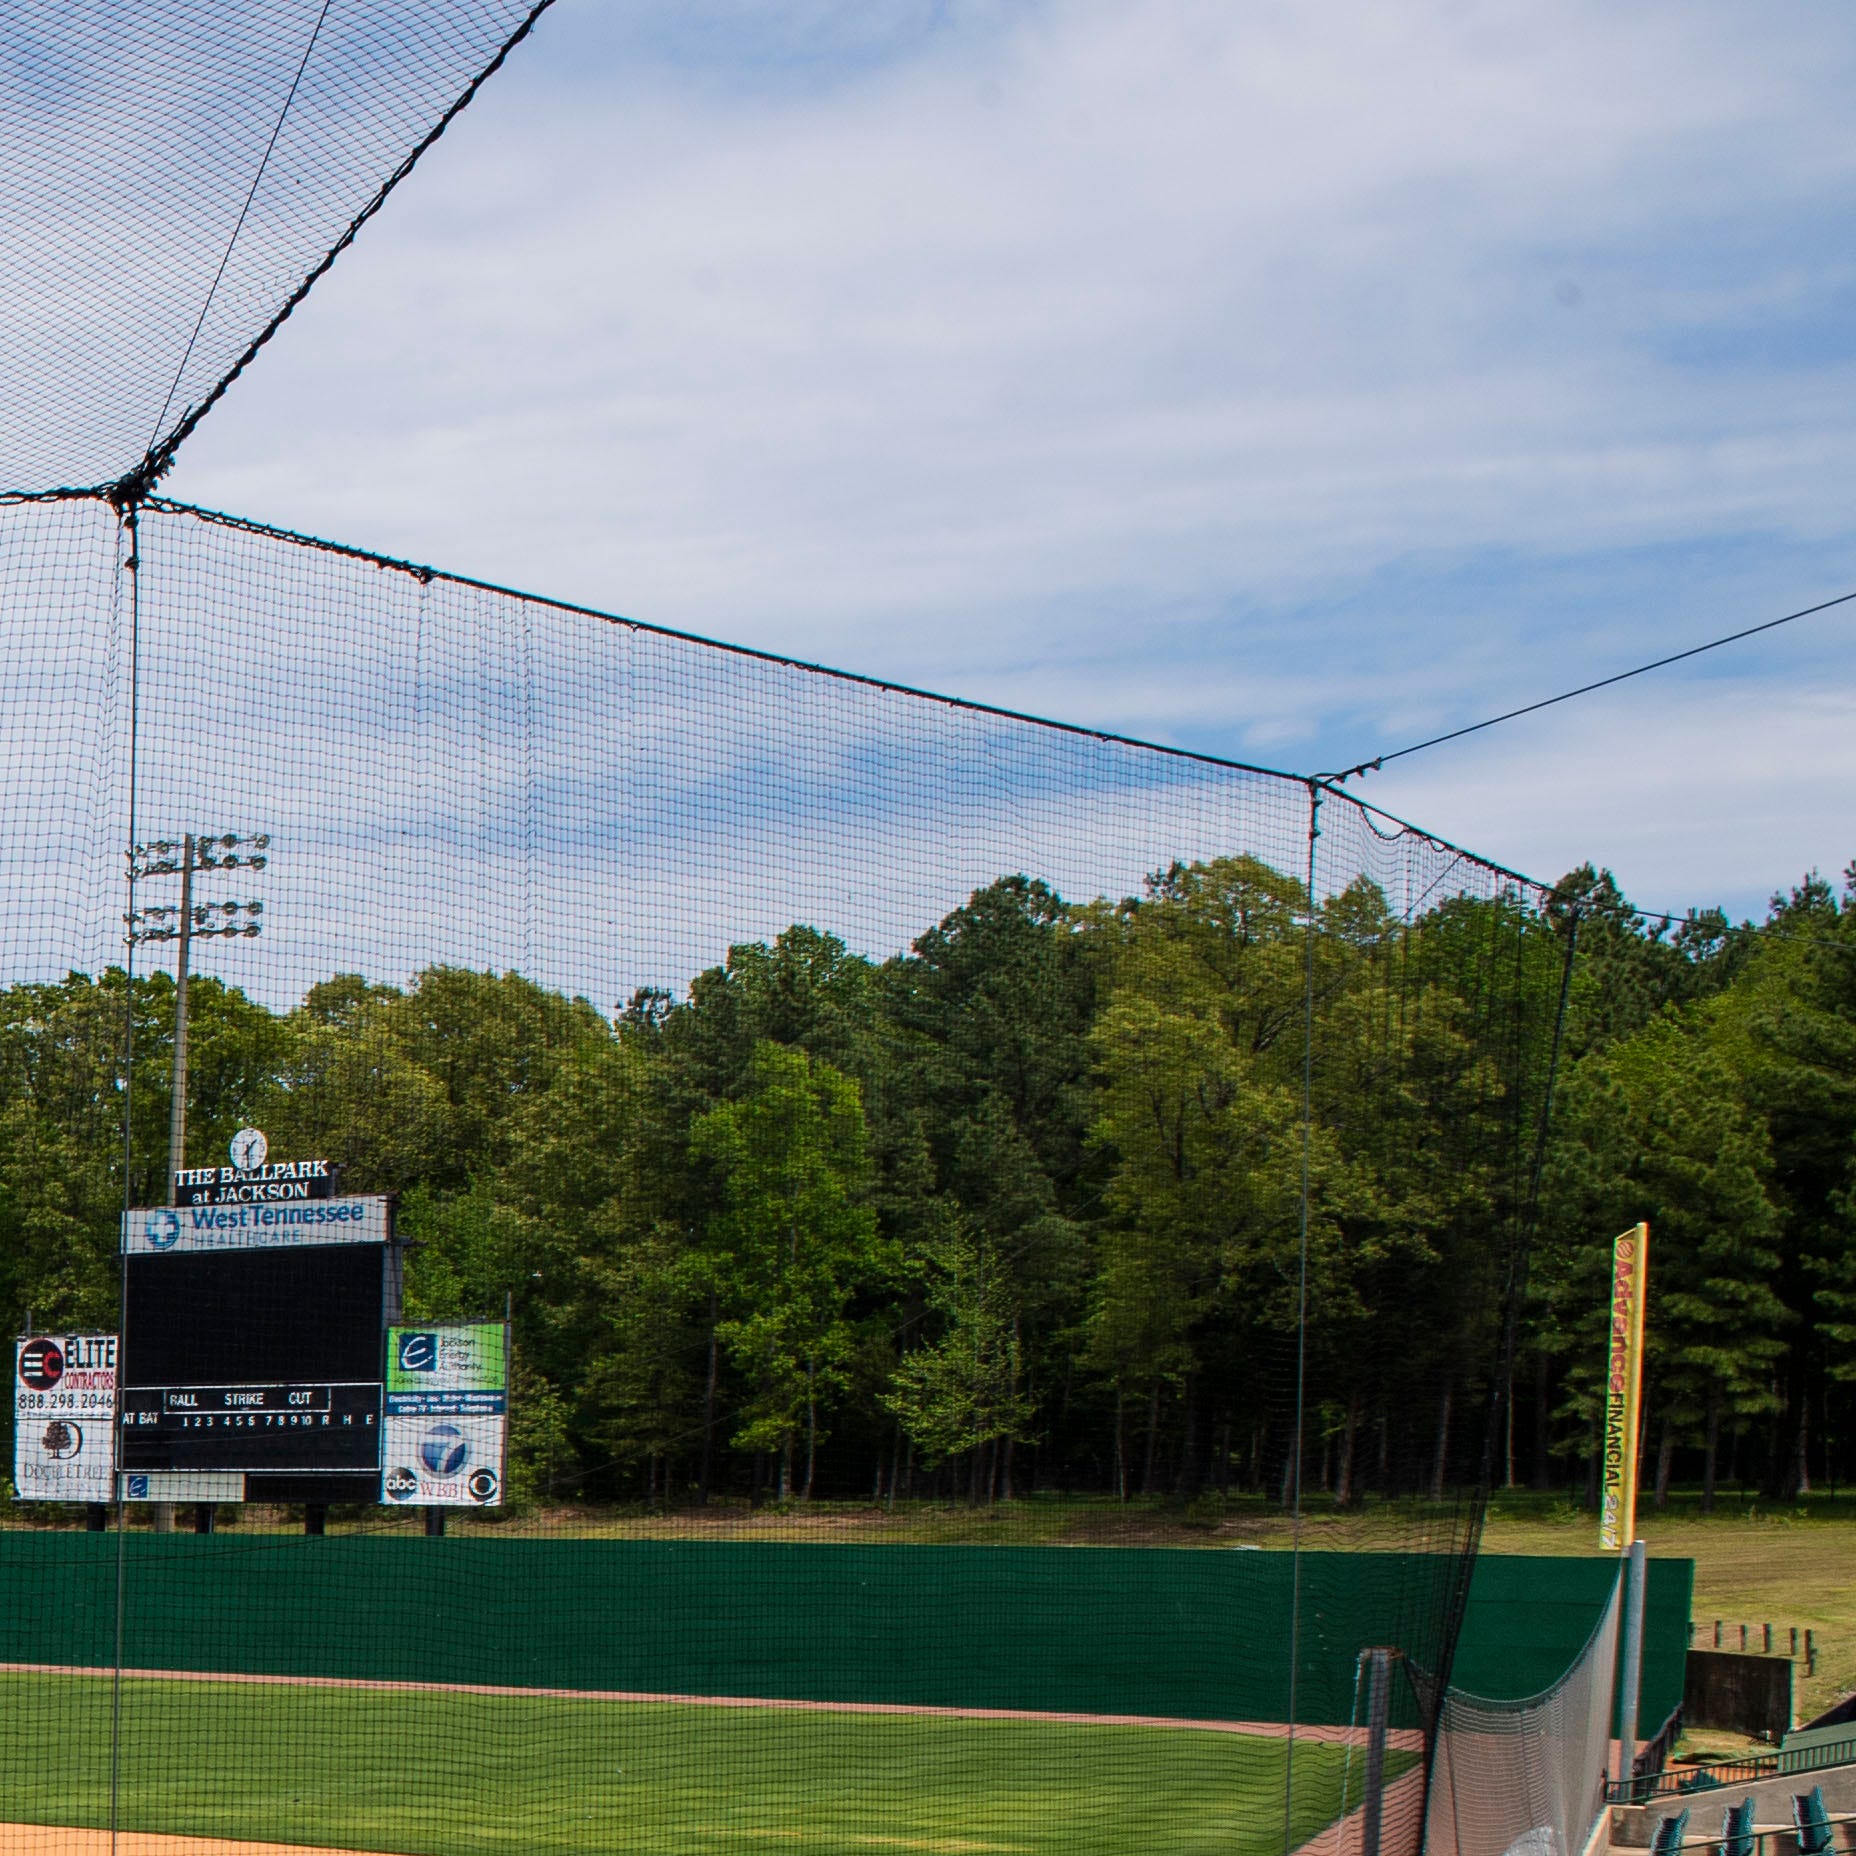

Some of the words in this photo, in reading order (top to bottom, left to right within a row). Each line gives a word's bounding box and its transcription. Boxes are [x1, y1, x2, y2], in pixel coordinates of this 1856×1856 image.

[175, 1168, 216, 1186] THE
[220, 1161, 329, 1183] BALLPARK
[192, 1189, 210, 1204] at
[215, 1182, 309, 1203] JACKSON
[191, 1208, 248, 1230] West
[249, 1203, 364, 1227] Tennessee
[64, 1339, 116, 1369] ELITE
[64, 1372, 114, 1390] CONTRACTORS
[19, 1393, 113, 1409] 888.298.2046
[170, 1394, 199, 1407] BALL
[224, 1393, 264, 1406] STRIKE
[288, 1391, 313, 1405] OUT
[122, 1412, 135, 1425] AT
[138, 1412, 159, 1425] BAT
[194, 1416, 202, 1427] 2
[206, 1416, 214, 1427] 3
[223, 1416, 230, 1426] 4
[236, 1416, 243, 1427] 5
[248, 1416, 255, 1426] 6
[266, 1416, 272, 1426] 7
[278, 1416, 285, 1426] 8
[290, 1416, 298, 1426] 9
[301, 1415, 312, 1426] 10
[321, 1415, 330, 1426] R
[344, 1415, 352, 1425] H
[365, 1414, 374, 1425] E
[386, 1474, 416, 1491] abc
